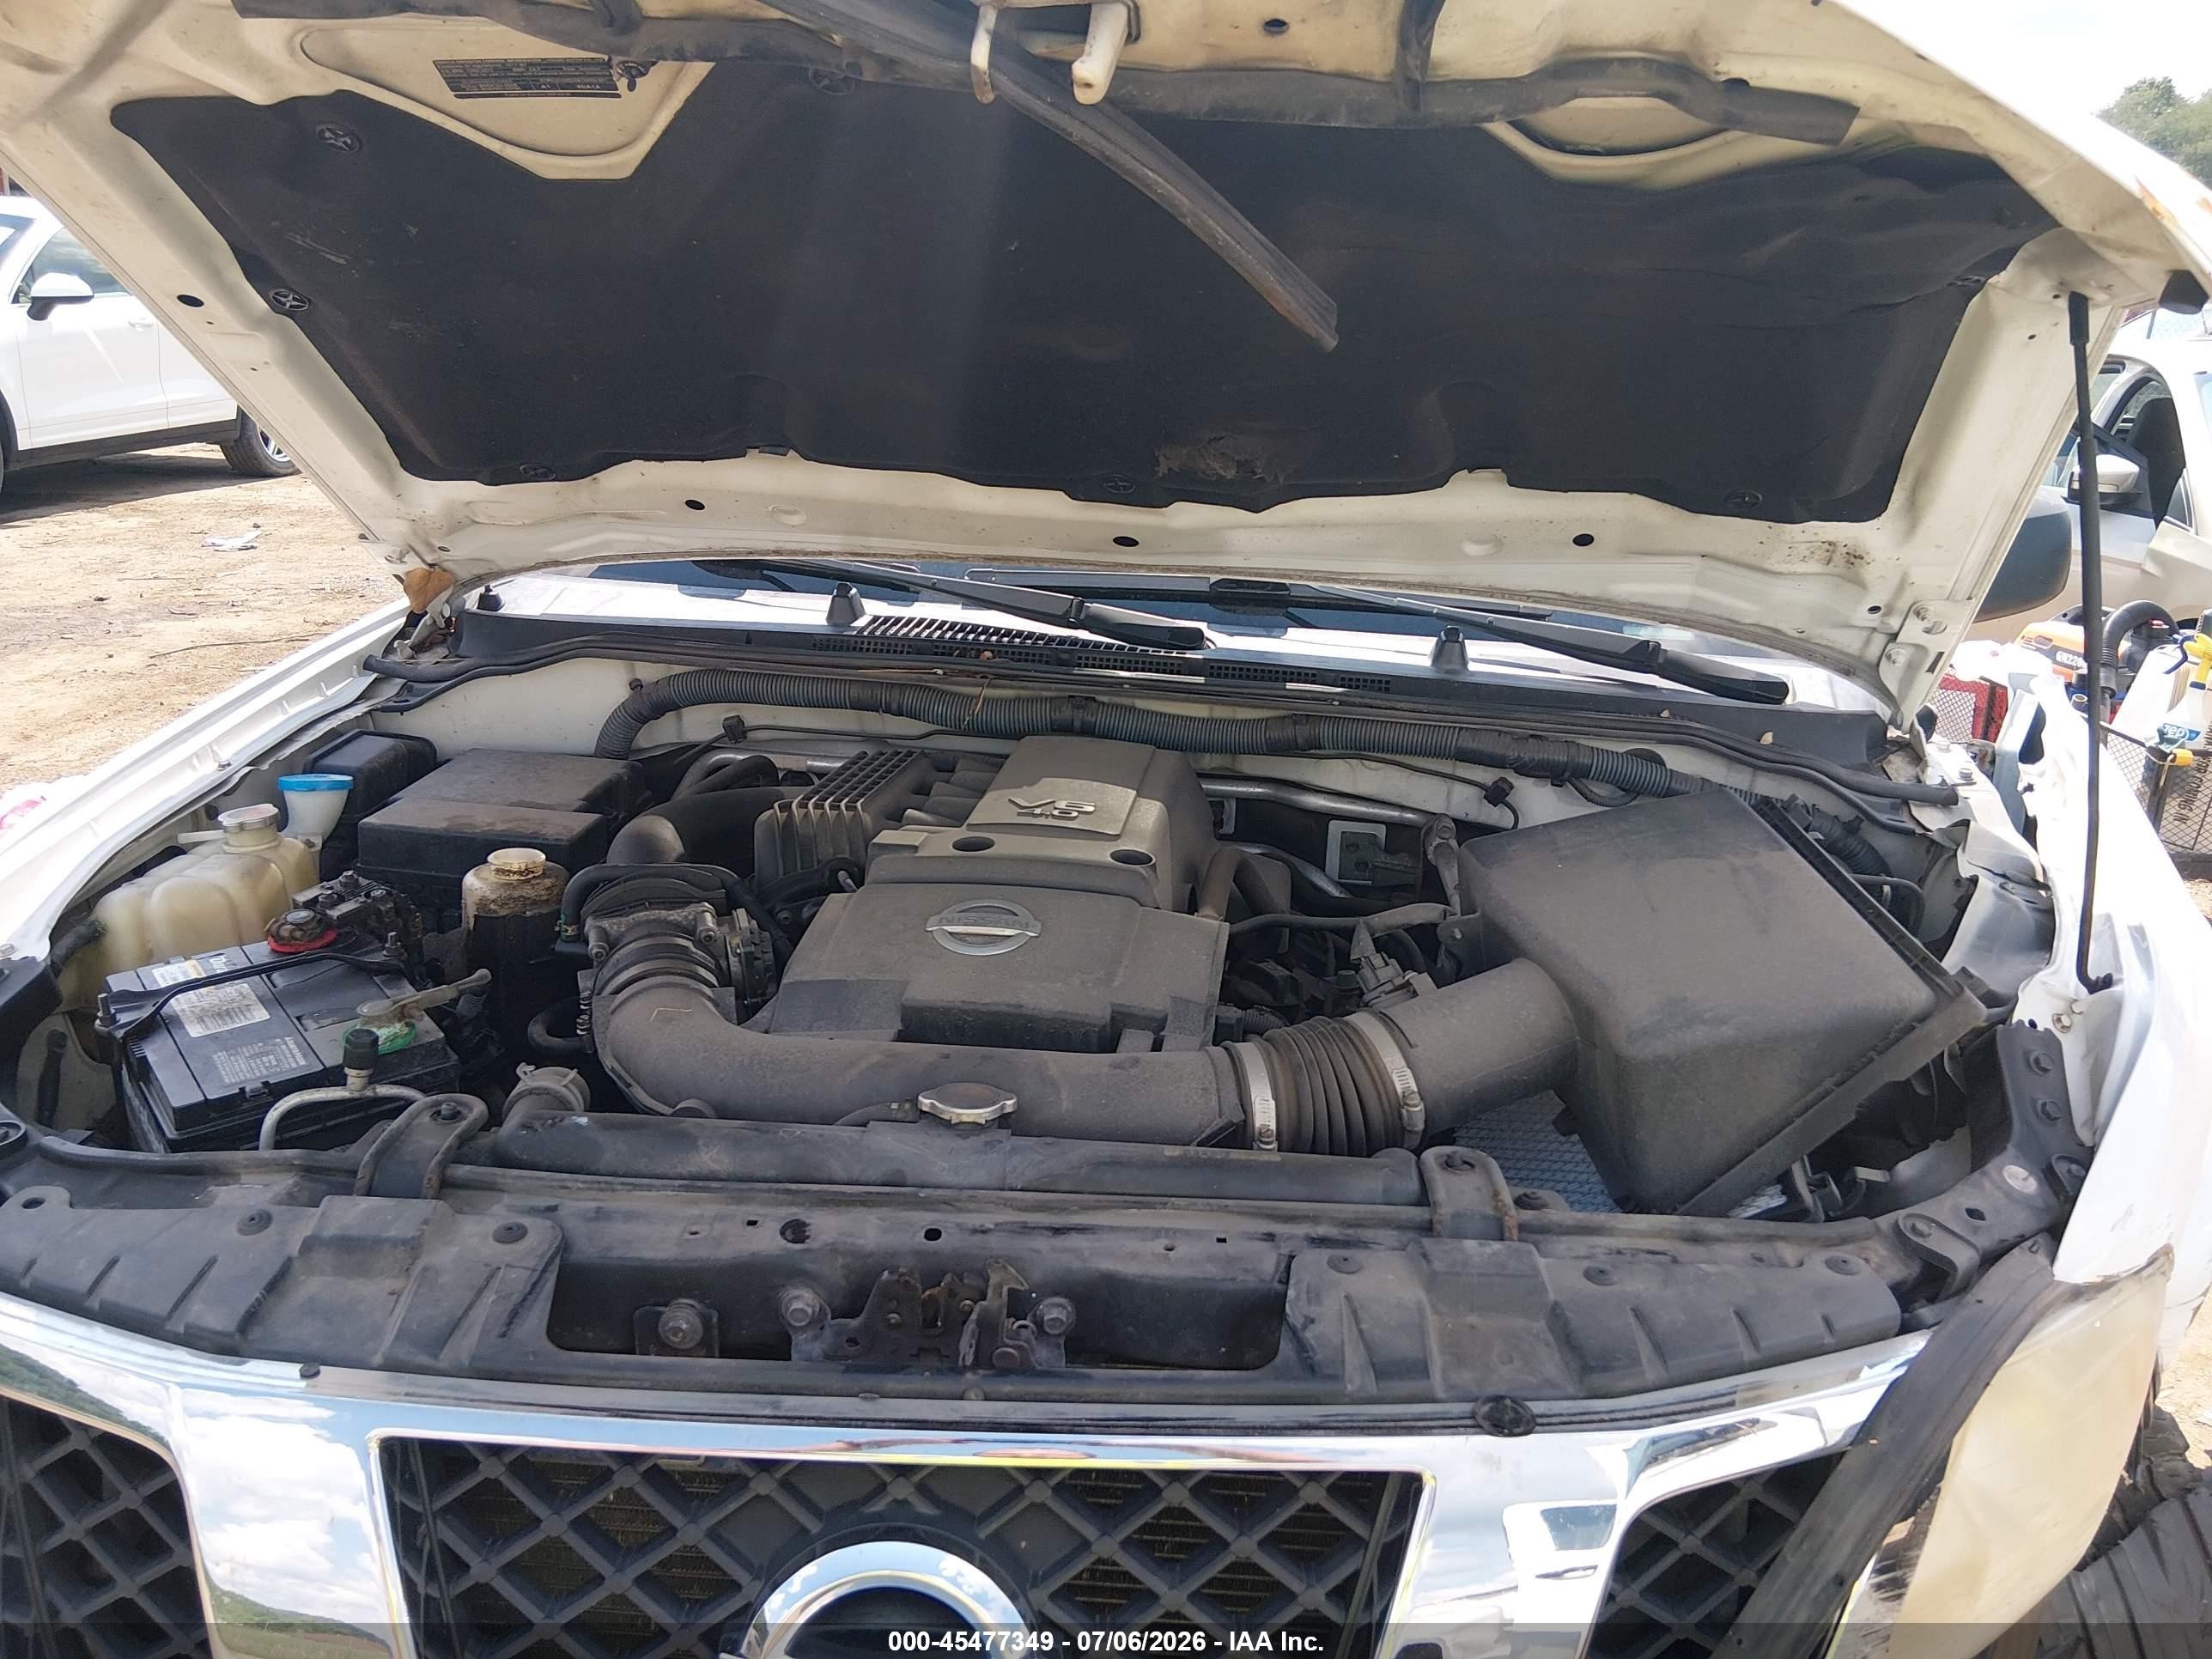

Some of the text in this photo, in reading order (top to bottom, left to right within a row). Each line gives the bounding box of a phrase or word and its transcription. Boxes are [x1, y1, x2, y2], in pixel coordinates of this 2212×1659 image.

[2178, 775, 2203, 812] COMING
[1007, 796, 1096, 814] V6
[1016, 807, 1079, 821] 4.0
[2172, 812, 2191, 824] IN
[939, 914, 1032, 929] NISSAN
